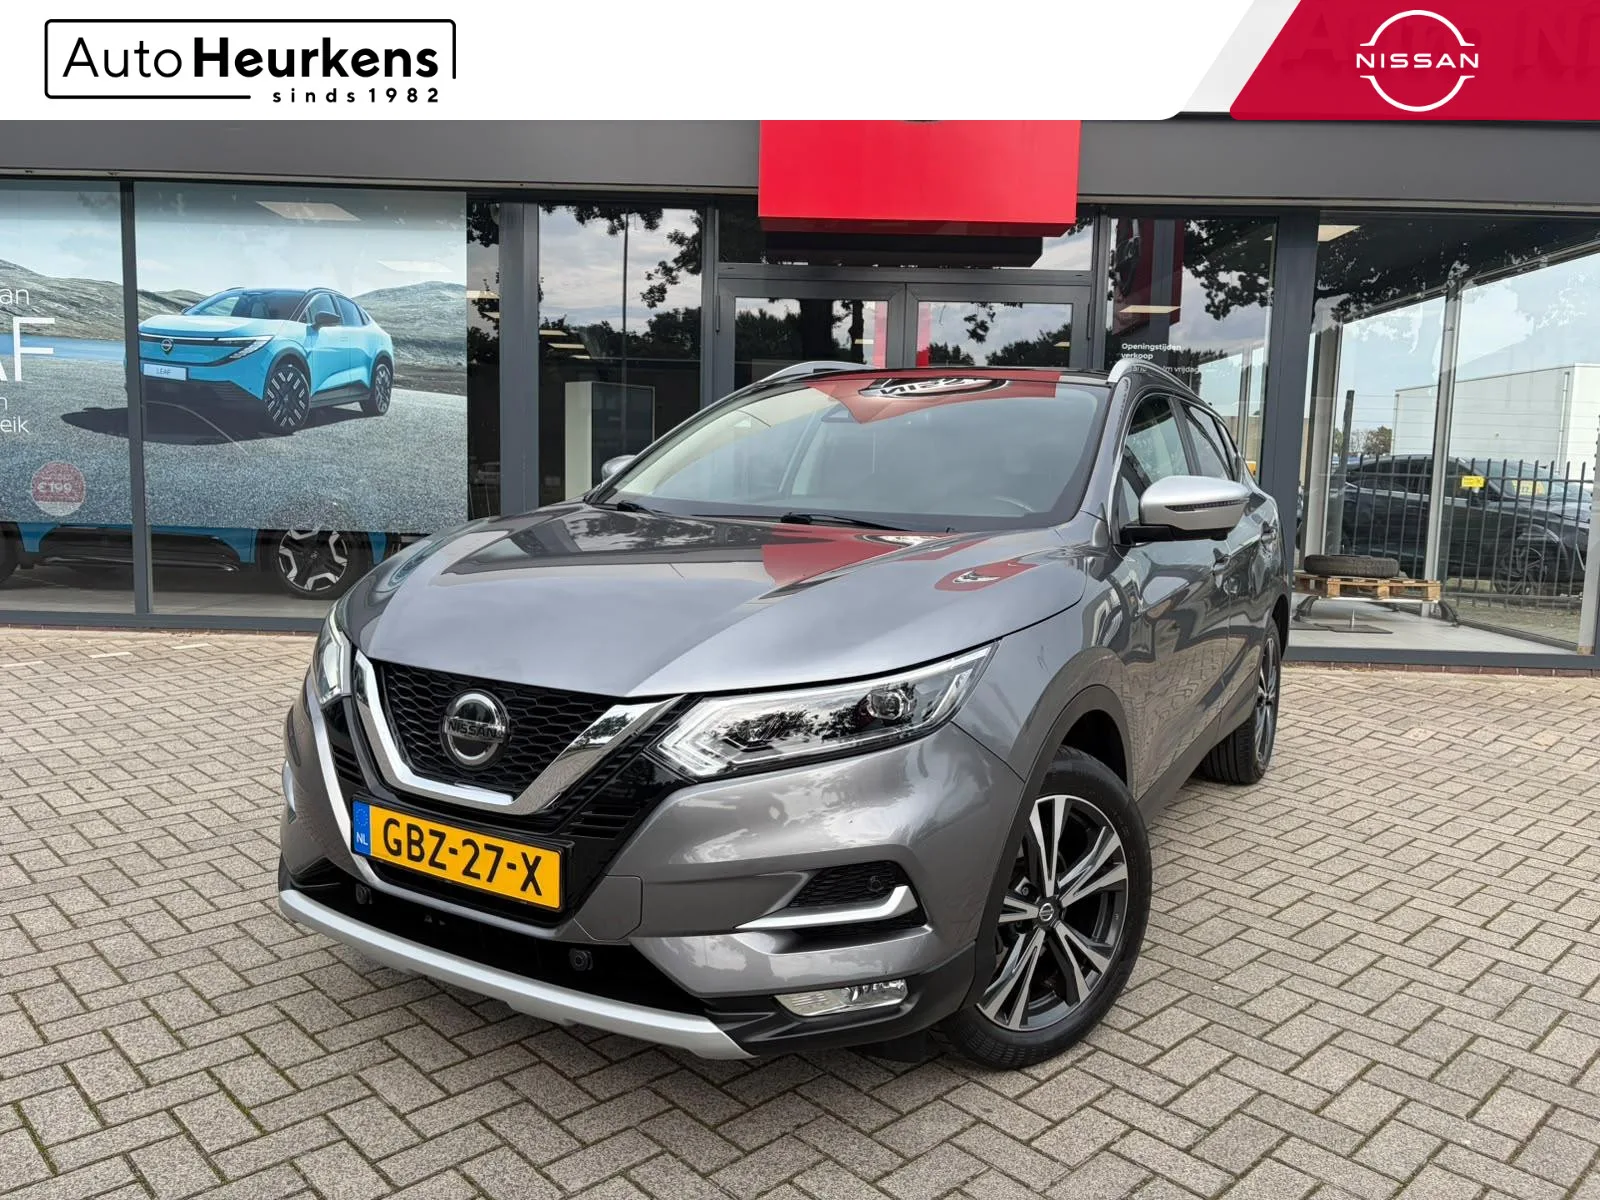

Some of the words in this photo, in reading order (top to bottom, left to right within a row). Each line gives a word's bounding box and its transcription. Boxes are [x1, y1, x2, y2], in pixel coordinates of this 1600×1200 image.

[1121, 342, 1182, 353] Openingstijden
[1120, 352, 1154, 361] verkoop
[449, 718, 499, 738] NISSAN
[356, 831, 369, 846] NL
[382, 817, 543, 897] GBZ-27-X
